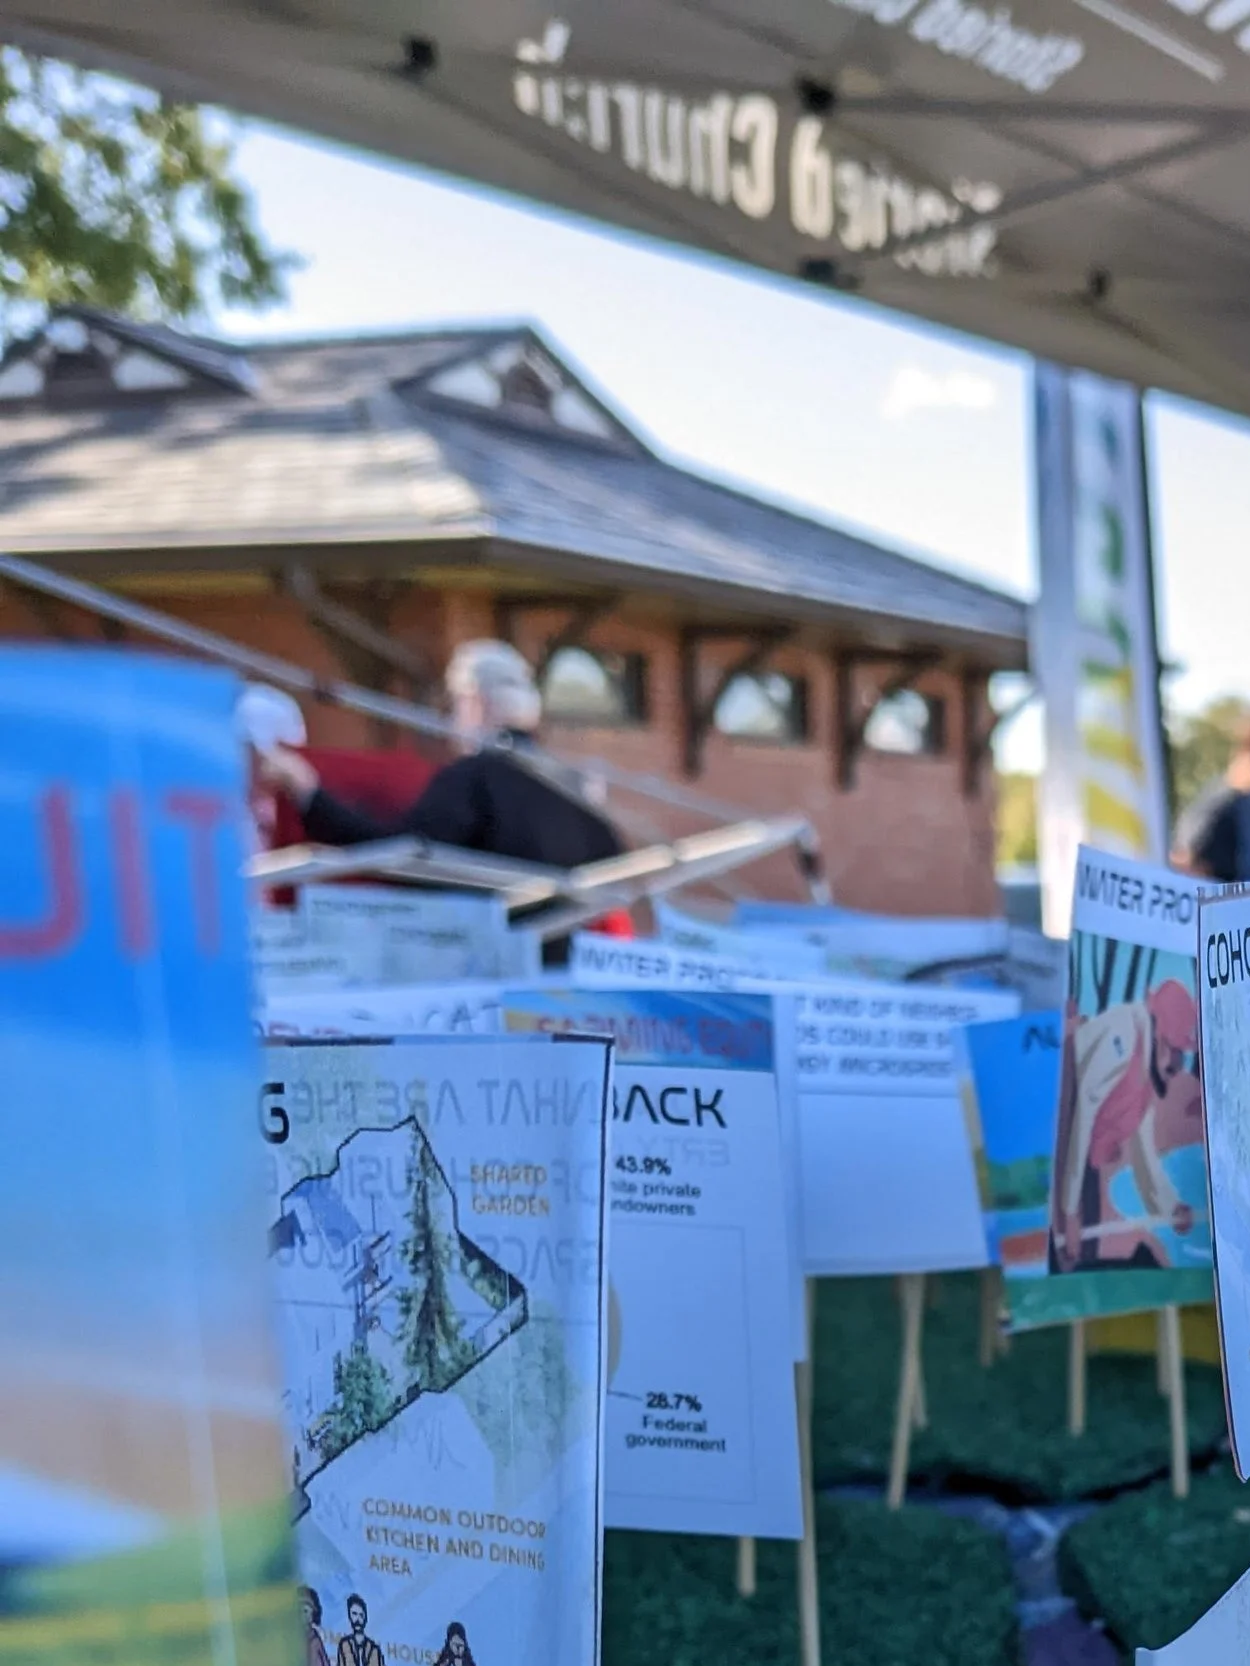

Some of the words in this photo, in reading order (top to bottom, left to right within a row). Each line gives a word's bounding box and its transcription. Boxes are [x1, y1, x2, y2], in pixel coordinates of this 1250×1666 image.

[1077, 862, 1143, 915] WATER
[612, 1083, 728, 1129] ACK
[615, 1155, 672, 1175] 43.9%
[643, 1181, 701, 1198] private
[611, 1199, 697, 1216] ndowners
[646, 1391, 703, 1413] 28.7%
[642, 1414, 708, 1433] Federal
[625, 1434, 727, 1453] government
[363, 1498, 452, 1527] COMMON
[457, 1510, 546, 1540] OUTDOOR
[365, 1526, 440, 1555] KITCHEN
[446, 1539, 484, 1560] AND
[489, 1543, 546, 1572] DINING
[369, 1555, 413, 1577] AREA
[387, 1641, 441, 1666] HOUS
